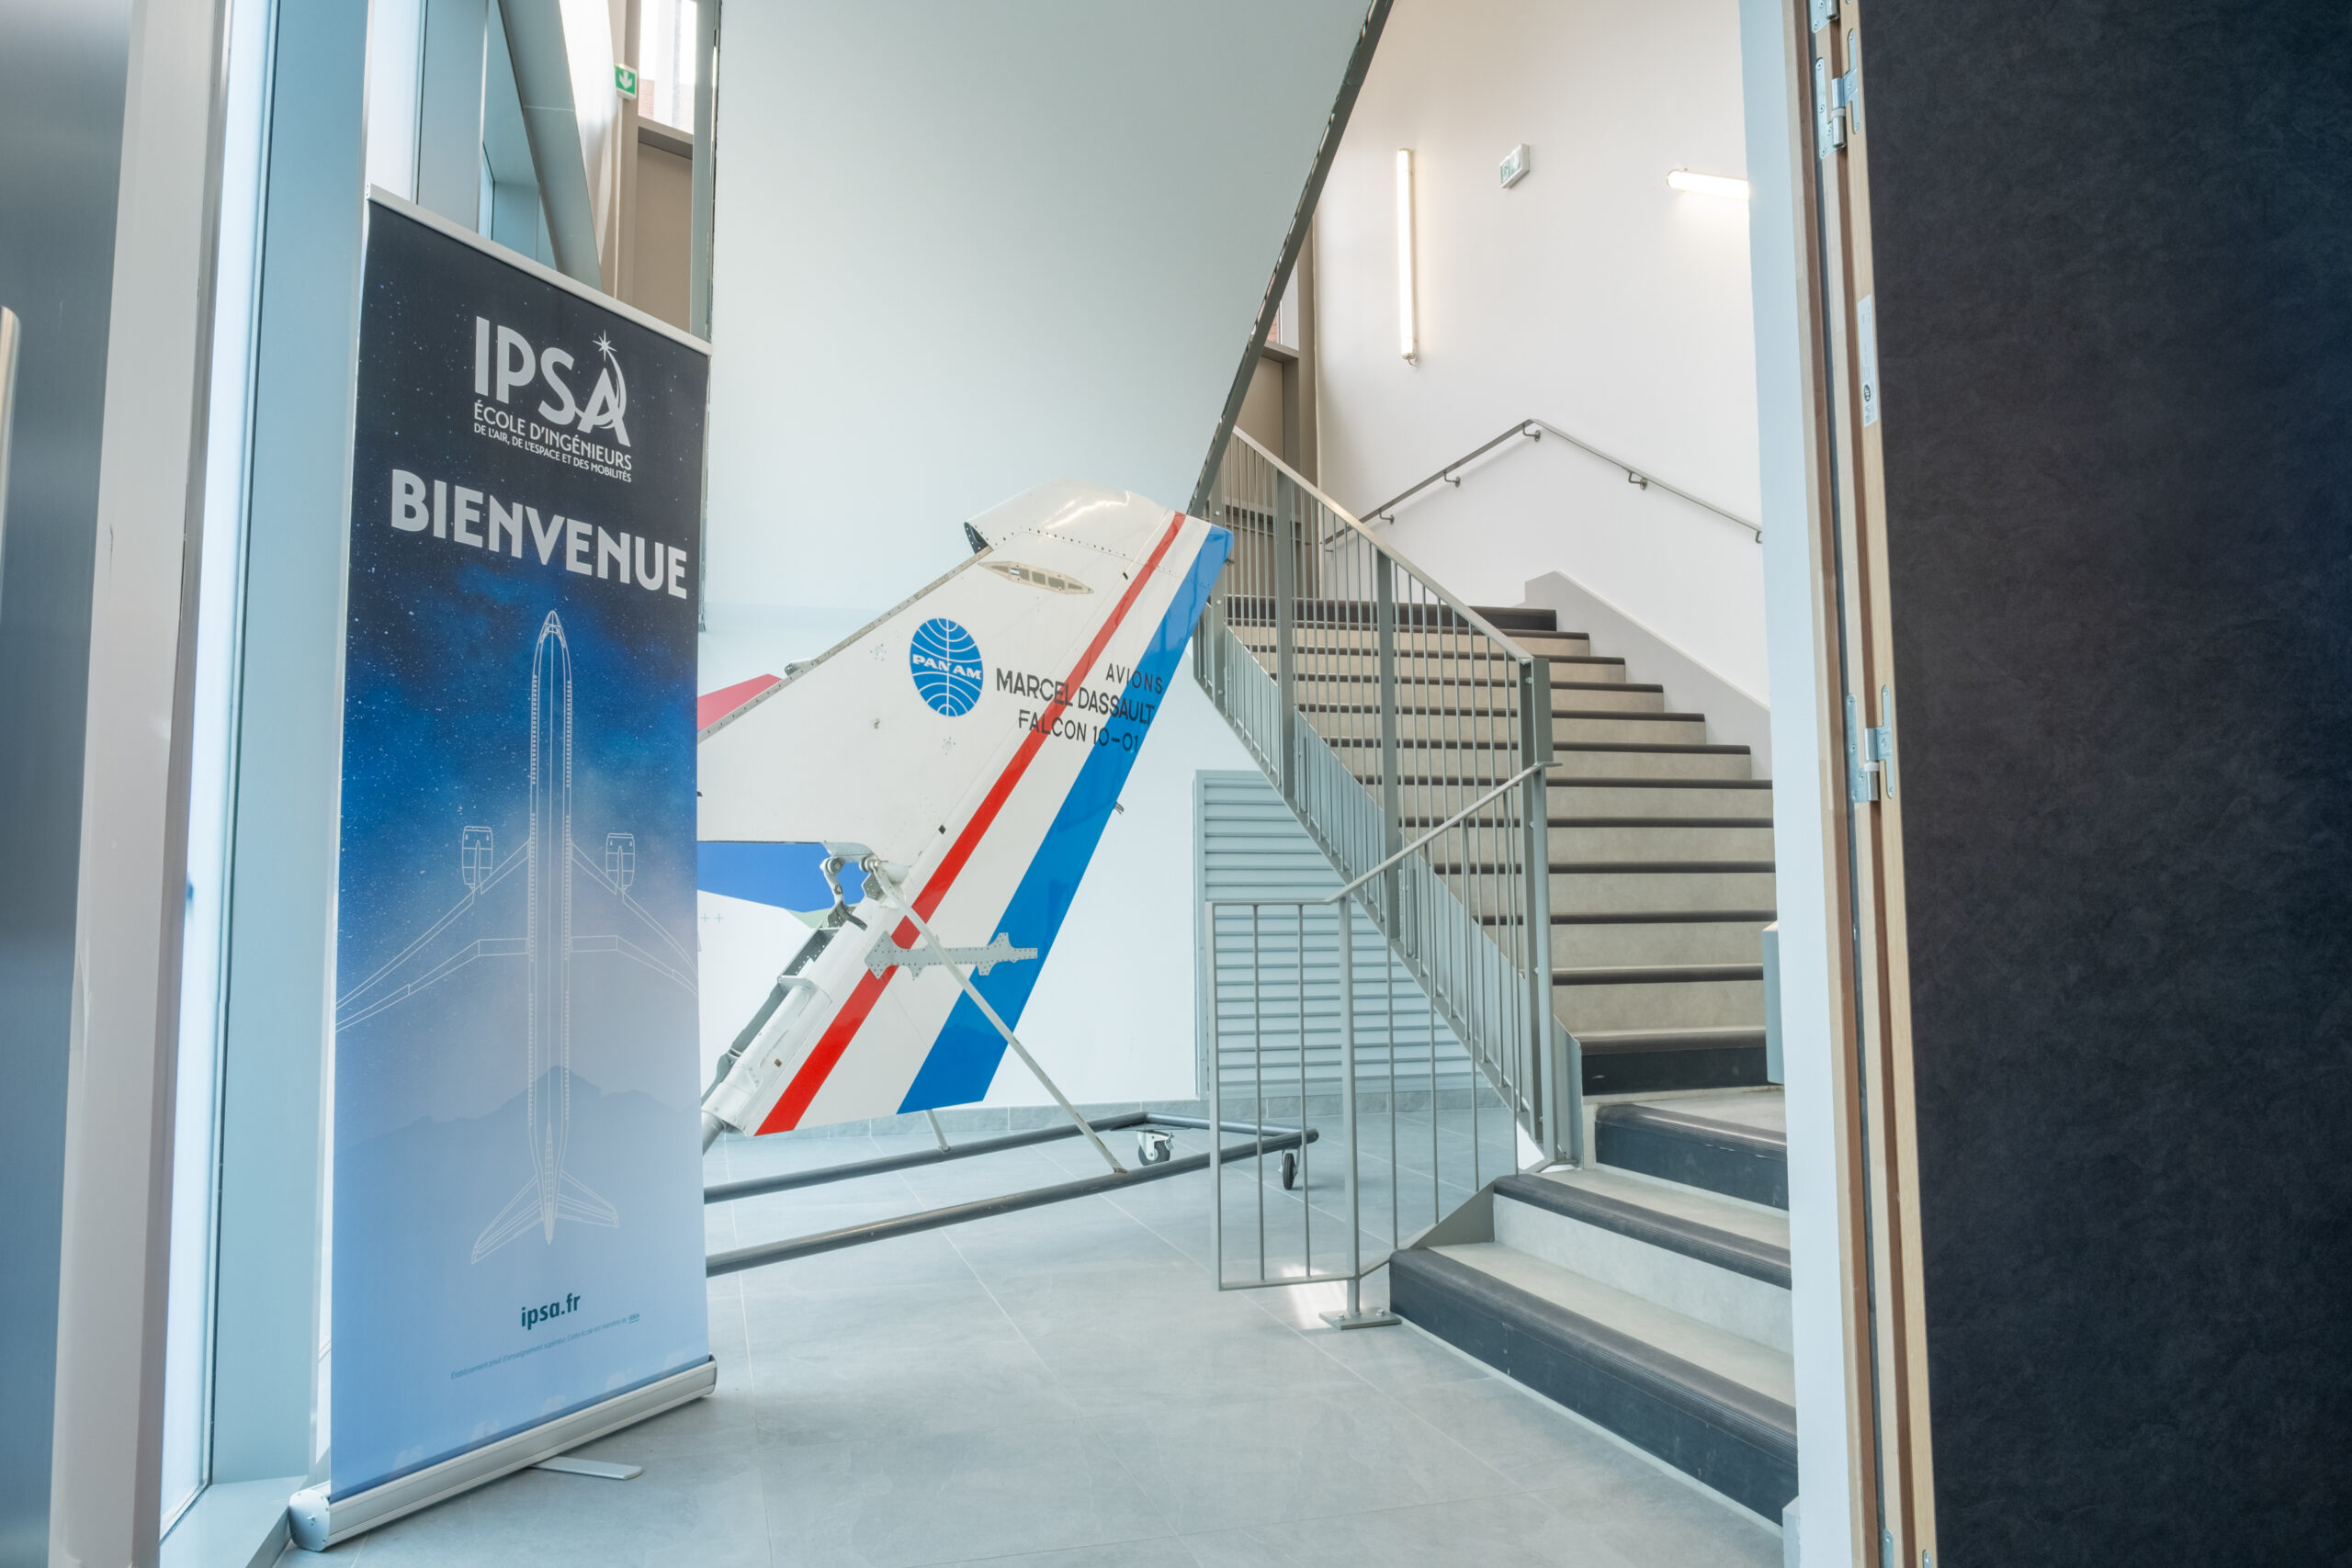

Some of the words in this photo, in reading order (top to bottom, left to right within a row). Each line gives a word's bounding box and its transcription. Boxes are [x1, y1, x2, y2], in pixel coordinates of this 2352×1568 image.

[473, 315, 631, 448] IPSA
[473, 399, 526, 436] ÉCOLE
[530, 422, 632, 471] D'INGÉNIEURS
[473, 423, 486, 436] DE
[488, 428, 510, 446] L'AIR,
[512, 435, 524, 449] DE
[525, 440, 560, 462] L'ESPACE
[561, 454, 572, 465] ET
[573, 457, 589, 470] DES
[591, 463, 632, 483] MOBILITÉS
[390, 468, 687, 600] BIENVENUE
[912, 653, 952, 672] PAN
[952, 664, 982, 681] AM
[996, 667, 1074, 707] MARCEL
[1078, 686, 1156, 726] DASSAULT
[1105, 662, 1163, 695] AVIONS
[1018, 708, 1088, 743] FALCON
[1092, 725, 1139, 753] 10-01
[521, 1292, 581, 1331] ipsa.fr
